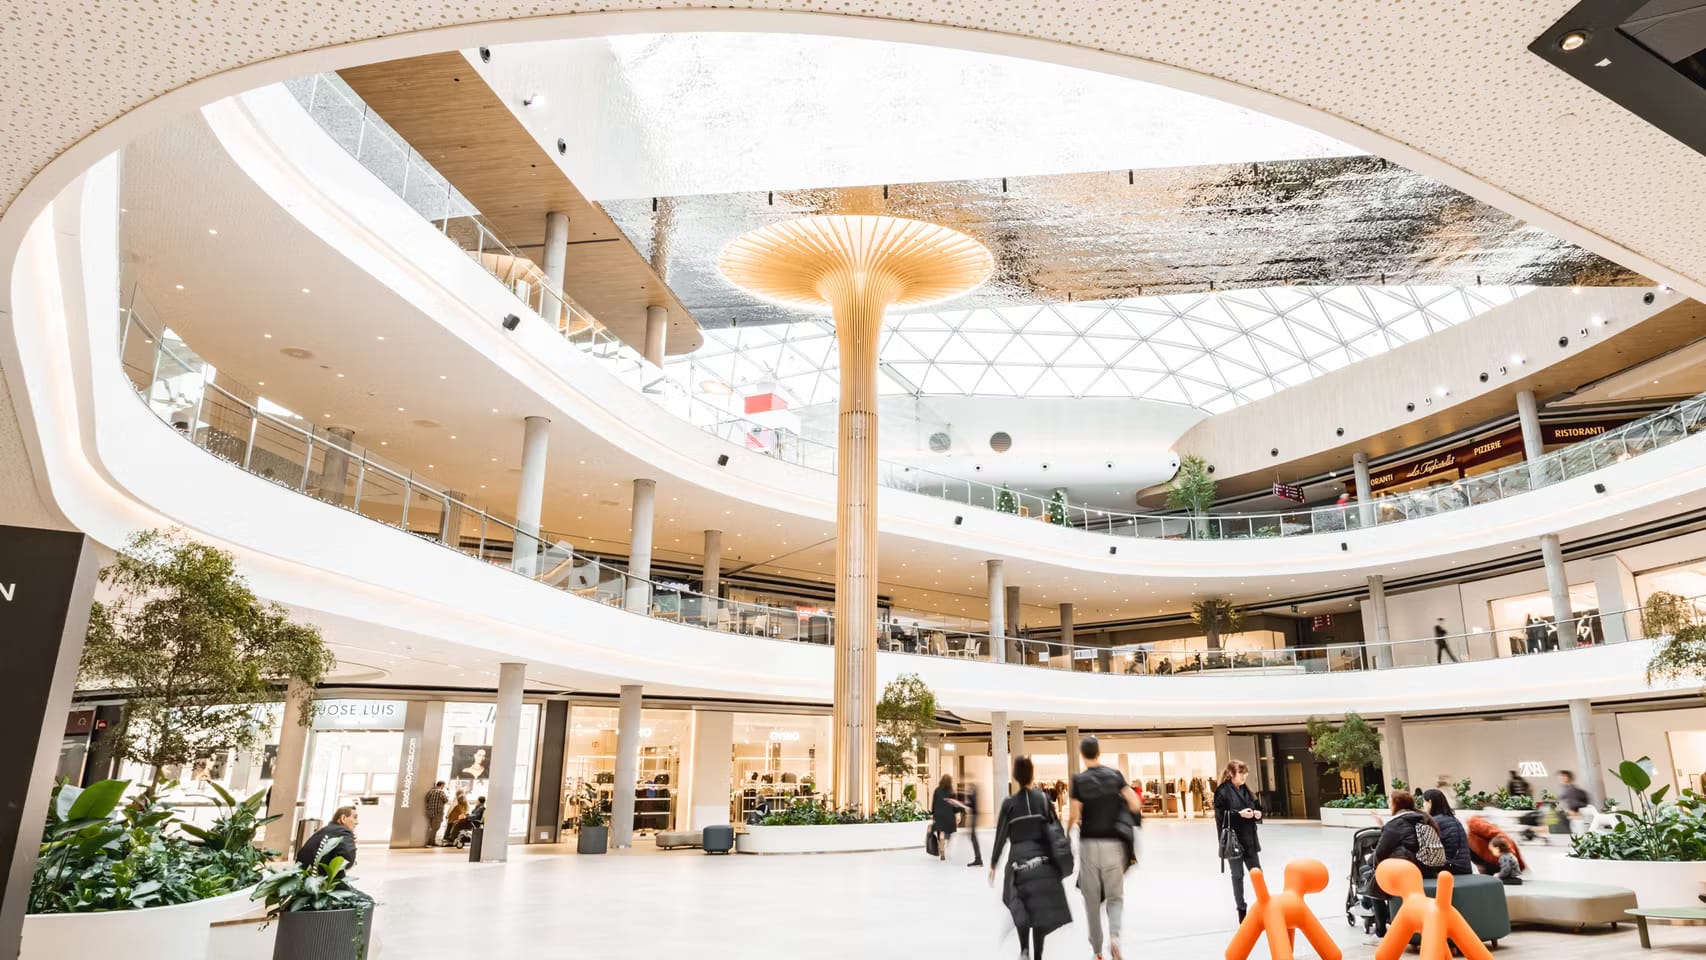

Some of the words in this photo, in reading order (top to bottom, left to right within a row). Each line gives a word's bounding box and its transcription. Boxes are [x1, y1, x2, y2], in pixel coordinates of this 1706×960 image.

[1554, 426, 1606, 438] RISTORANTI
[1473, 439, 1502, 456] PIZZERIE
[1370, 473, 1393, 486] ORANTI
[318, 704, 357, 716] JOSE
[363, 704, 395, 716] LUIS
